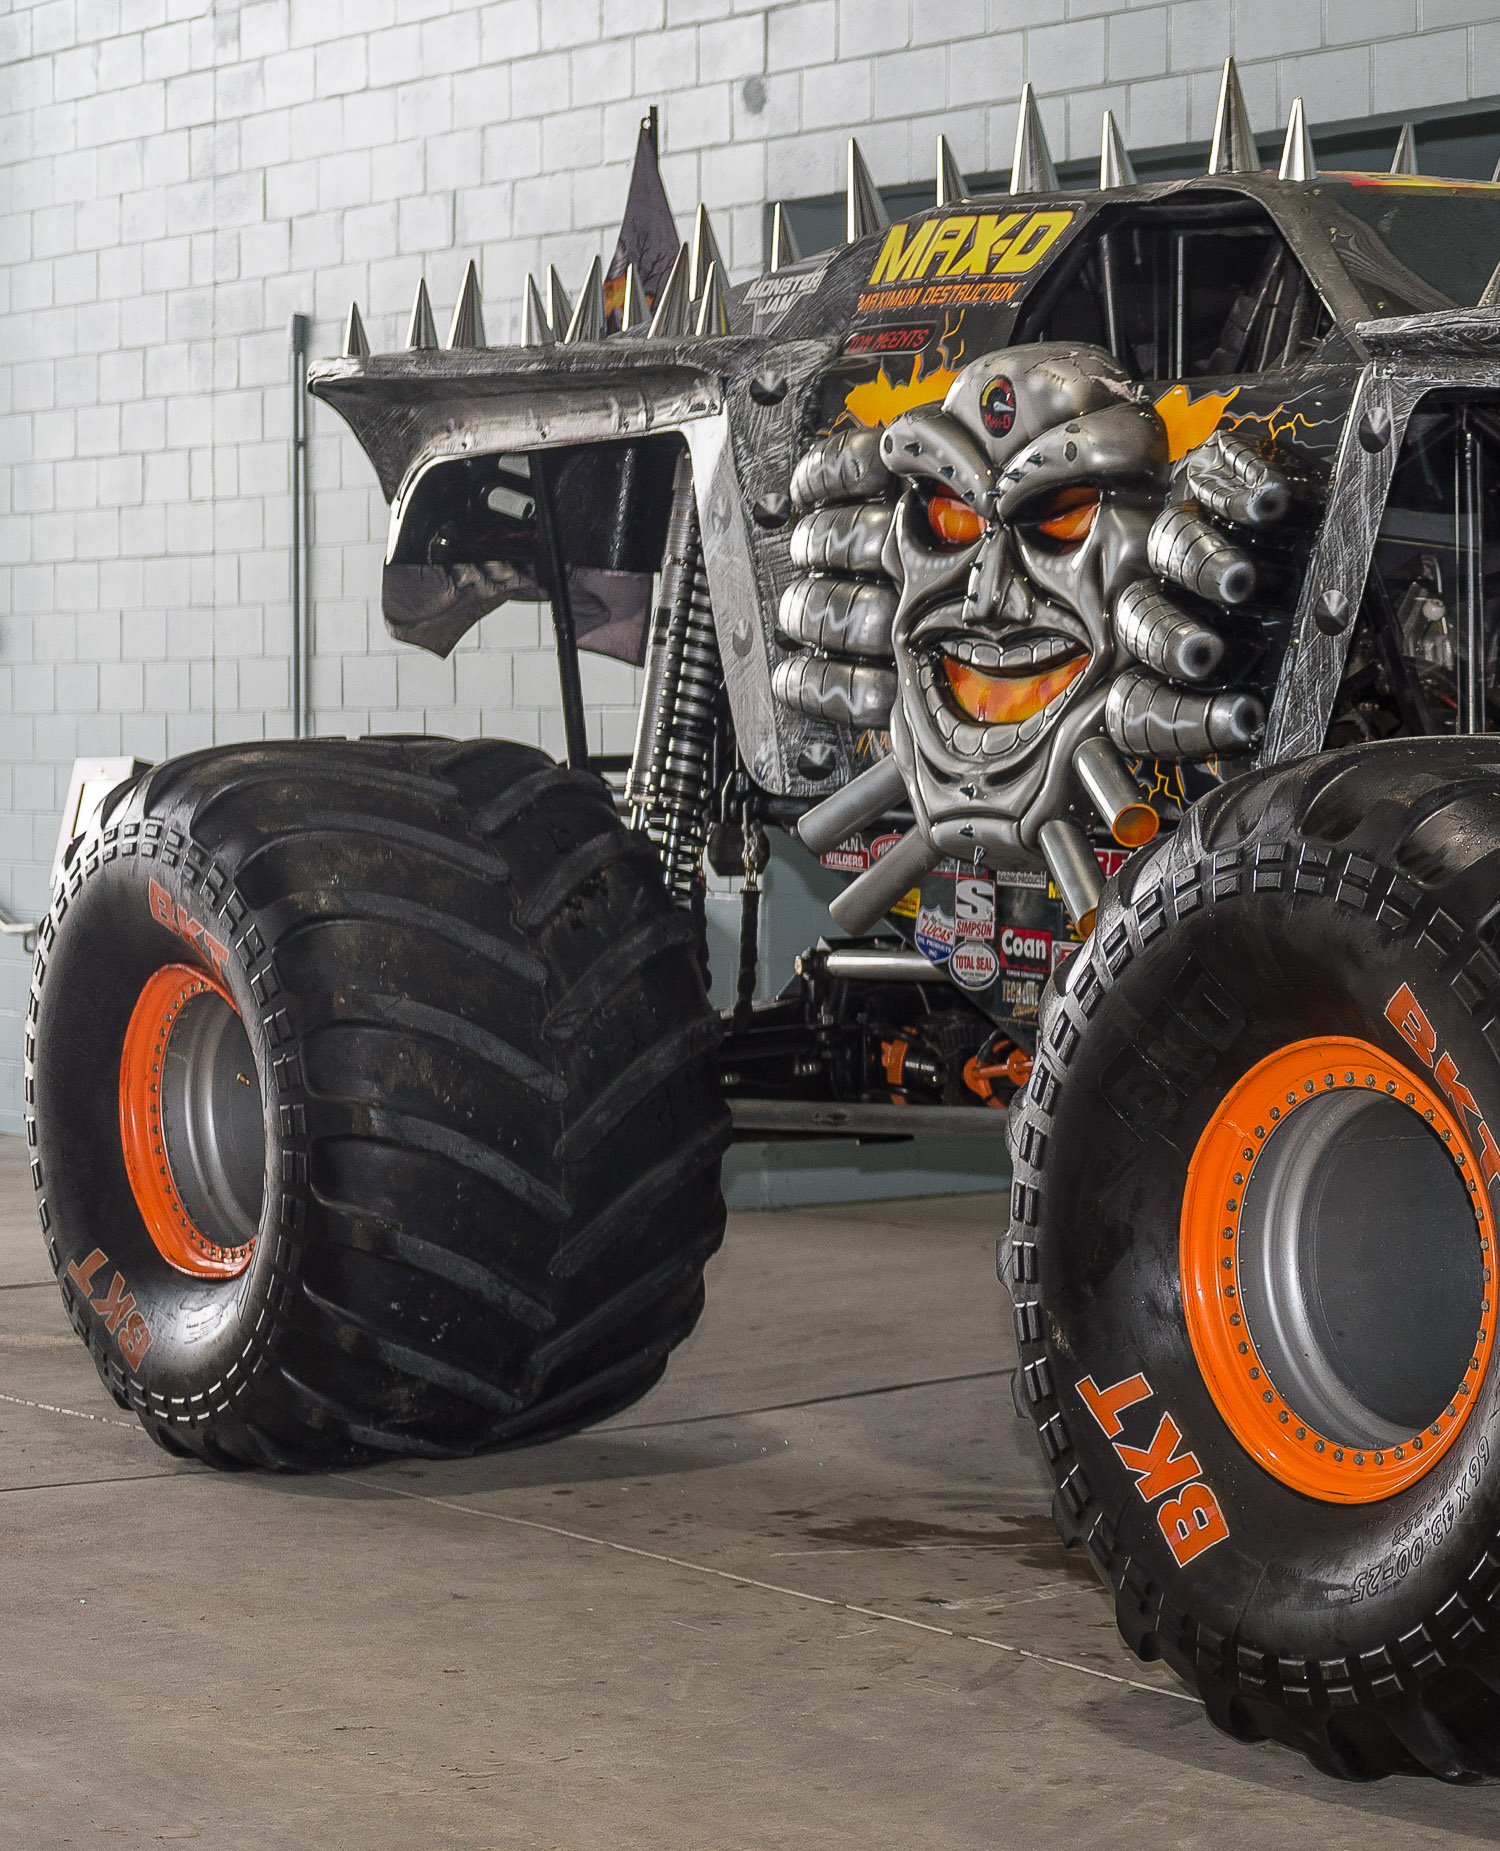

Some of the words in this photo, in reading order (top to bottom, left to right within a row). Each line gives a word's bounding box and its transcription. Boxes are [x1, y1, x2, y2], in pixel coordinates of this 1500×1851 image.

[868, 209, 1075, 286] MAX-D
[742, 269, 828, 305] MONSTER
[857, 286, 922, 313] MAXIMUM
[920, 281, 1024, 306] DESTRUCTION
[757, 294, 797, 317] JAM
[849, 334, 875, 354] TOM
[873, 328, 930, 350] MEENTS
[825, 851, 864, 868] WELDERS
[148, 876, 230, 979] BKT
[920, 922, 954, 942] LUCAS
[955, 919, 993, 937] SIMPSON
[1001, 928, 1047, 961] Coan
[954, 954, 975, 970] TOTAL
[975, 956, 993, 972] SEAL
[66, 1247, 155, 1374] BKT
[1074, 1371, 1231, 1569] BKT
